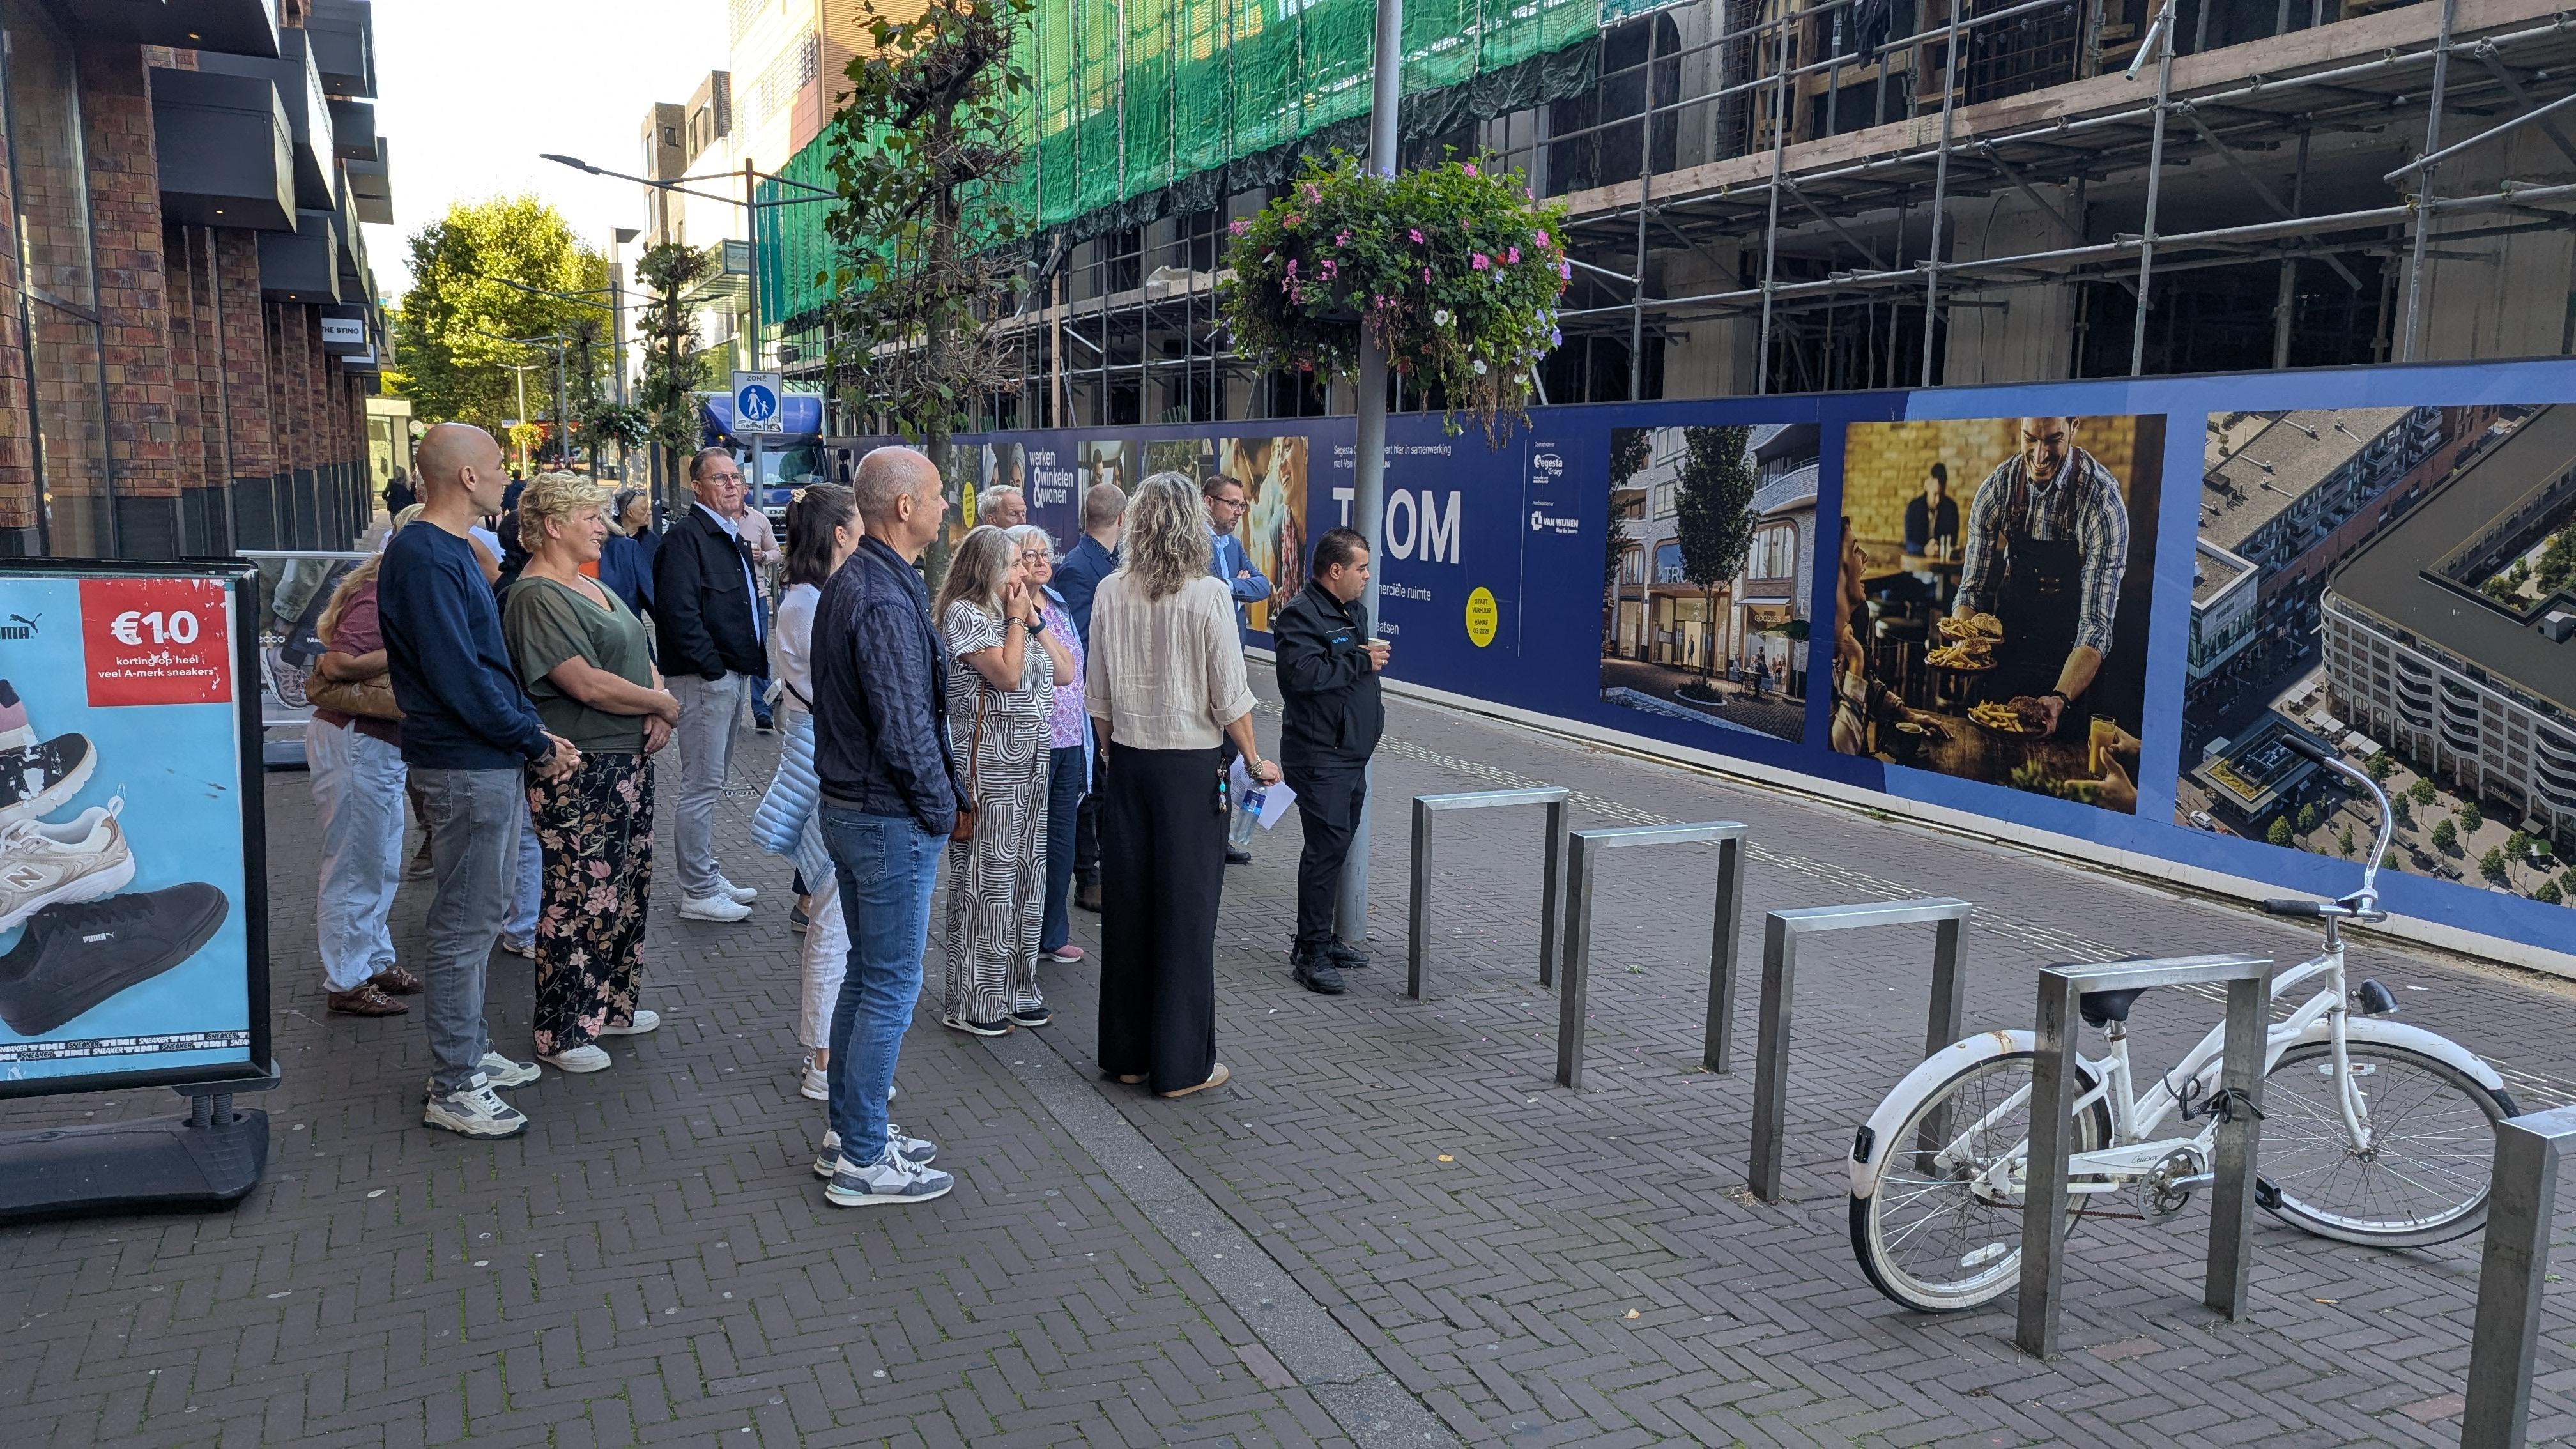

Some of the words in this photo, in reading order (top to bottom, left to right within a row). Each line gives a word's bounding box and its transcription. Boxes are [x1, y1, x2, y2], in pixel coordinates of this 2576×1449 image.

[1029, 447, 1055, 466] werken
[1333, 445, 1353, 457] Segesta
[1393, 444, 1404, 455] hier
[1405, 444, 1410, 454] in
[1411, 443, 1452, 456] samenwerking
[1333, 459, 1343, 468] met
[1343, 458, 1353, 468] Van
[1533, 454, 1563, 470] Segesta
[1548, 467, 1563, 477] Groep
[1033, 466, 1044, 509] &
[1040, 466, 1073, 487] winkelen
[1040, 488, 1067, 504] wonen
[1333, 487, 1461, 565] TOM
[1543, 518, 1555, 526] VAN
[1556, 518, 1579, 528] WIJNEN
[1407, 585, 1431, 601] ruimte
[1754, 614, 1781, 623] GOODIES
[0, 626, 29, 640] MA
[110, 611, 199, 645] €10
[116, 657, 155, 667] korting
[159, 657, 172, 666] op
[176, 656, 199, 664] heel
[98, 669, 121, 678] veel
[124, 668, 164, 677] A-merk
[82, 933, 107, 943] PUMA
[68, 1040, 100, 1050] SNEAKER
[139, 1036, 169, 1045] SNEAKER
[206, 1032, 237, 1041] SNEAKER
[20, 1050, 54, 1060] SNEAKER
[93, 1046, 123, 1055] SNEAKER
[162, 1041, 193, 1051] SNEAKER
[2131, 1154, 2159, 1164] Cruiser
